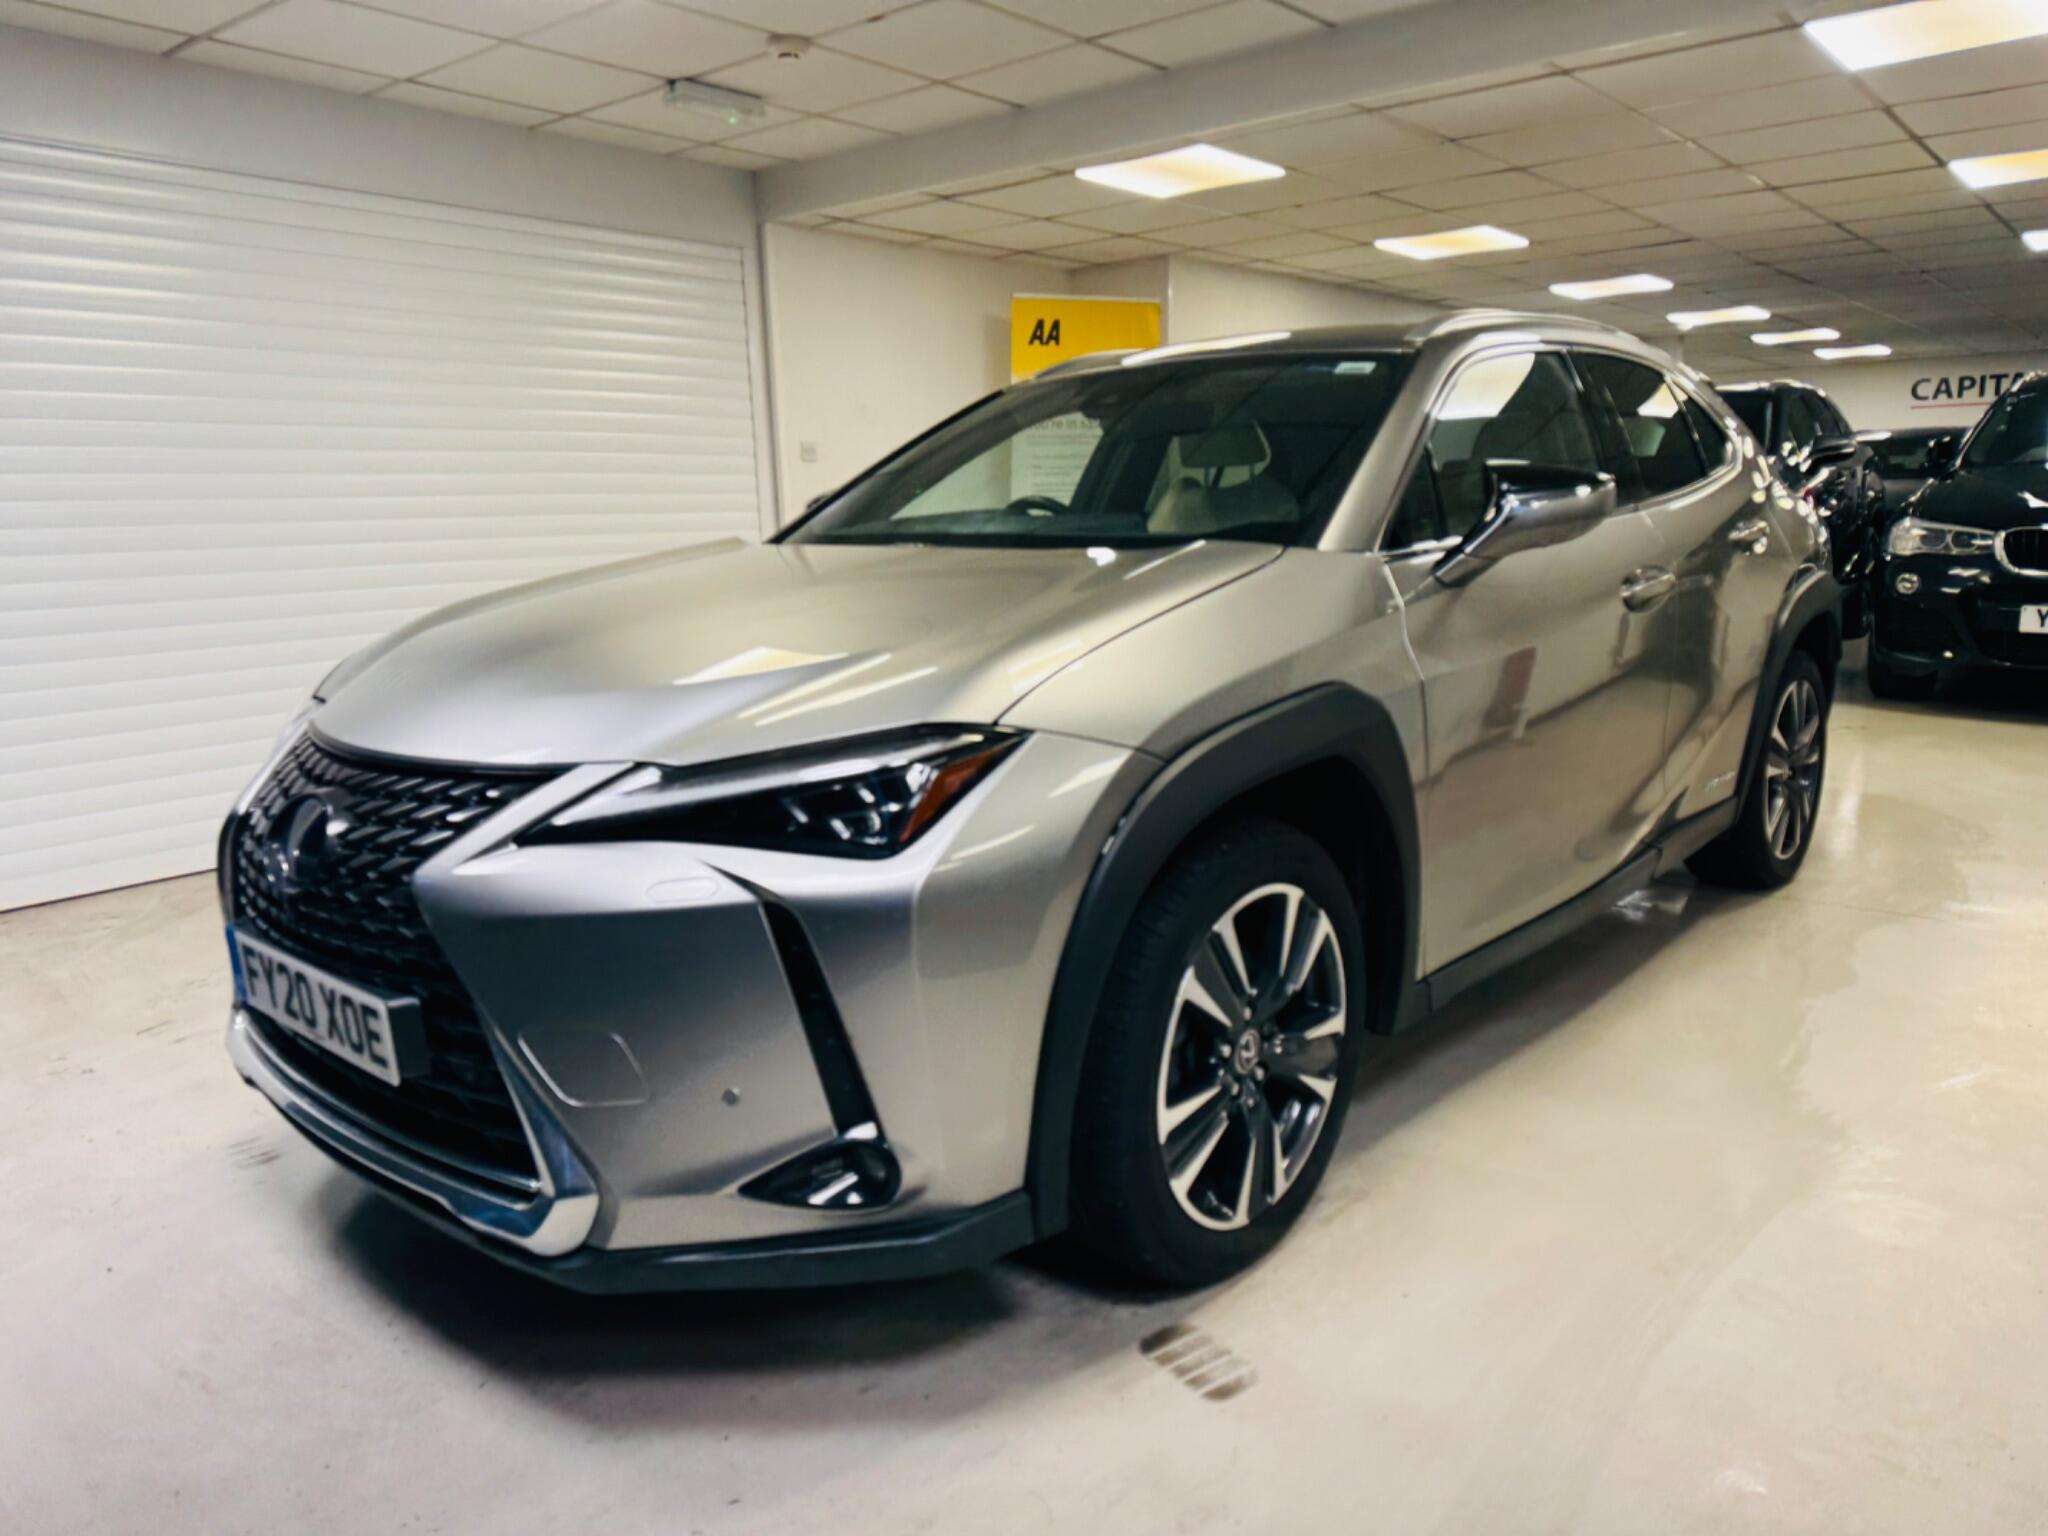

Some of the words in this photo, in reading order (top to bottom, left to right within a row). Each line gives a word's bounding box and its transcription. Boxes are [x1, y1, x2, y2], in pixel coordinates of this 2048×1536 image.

[1029, 319, 1060, 345] AA
[242, 944, 317, 1029] FY20
[318, 982, 388, 1069] XOE
